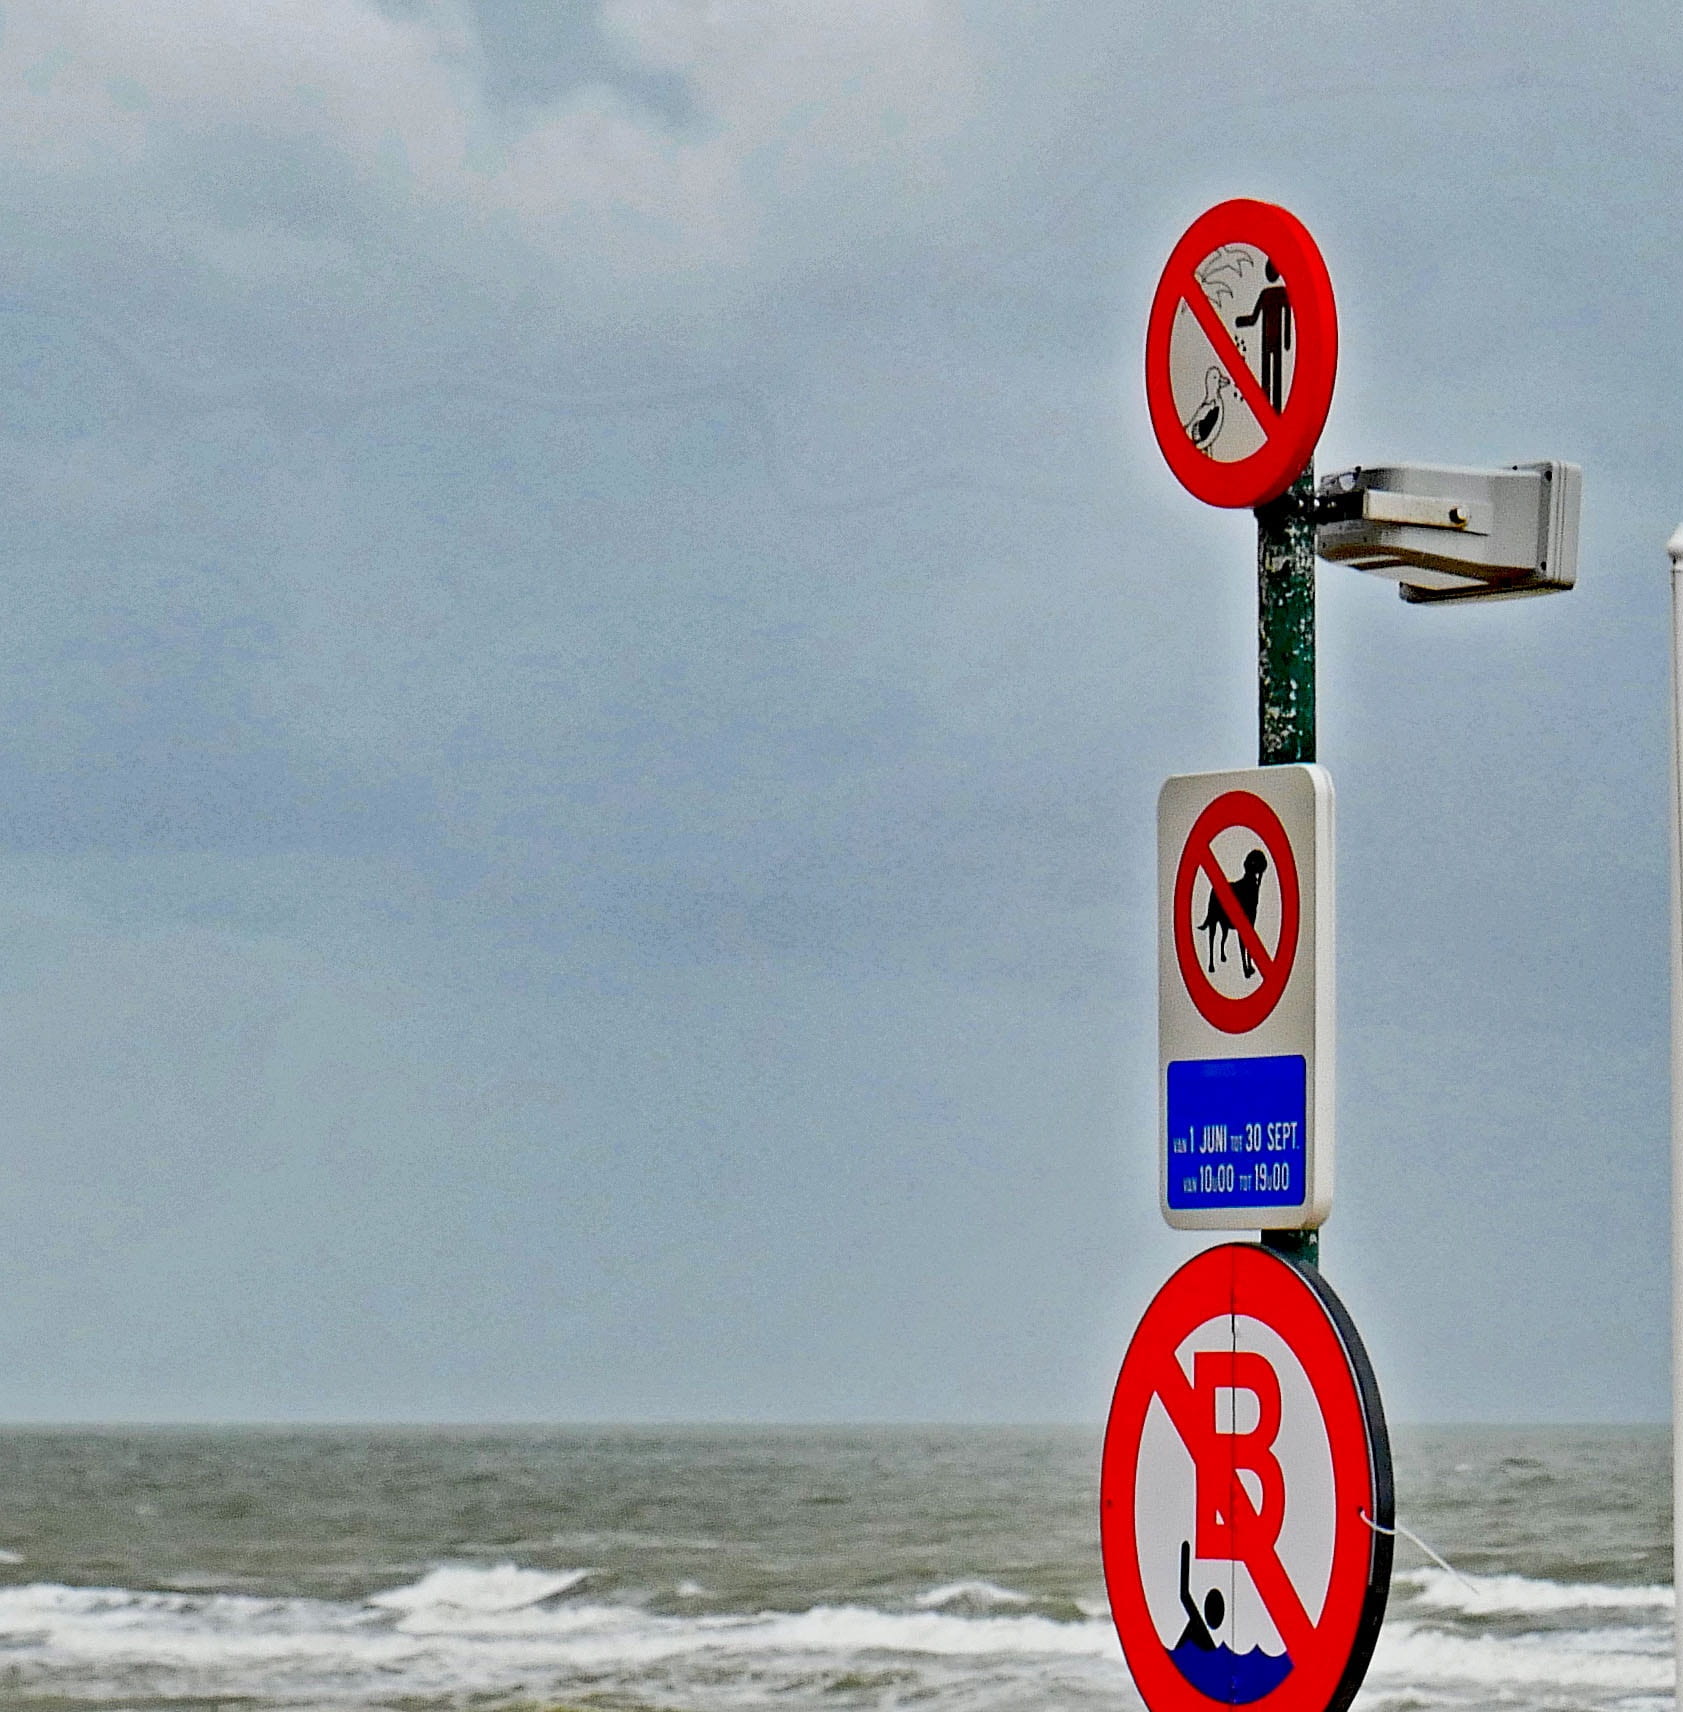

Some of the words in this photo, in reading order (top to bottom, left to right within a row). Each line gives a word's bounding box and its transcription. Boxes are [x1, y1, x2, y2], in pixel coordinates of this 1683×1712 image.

[1189, 1125, 1194, 1154] 1
[1200, 1124, 1228, 1154] JUNI
[1246, 1122, 1261, 1152] 30
[1267, 1121, 1300, 1151] SEPT.
[1194, 1351, 1285, 1560] B
